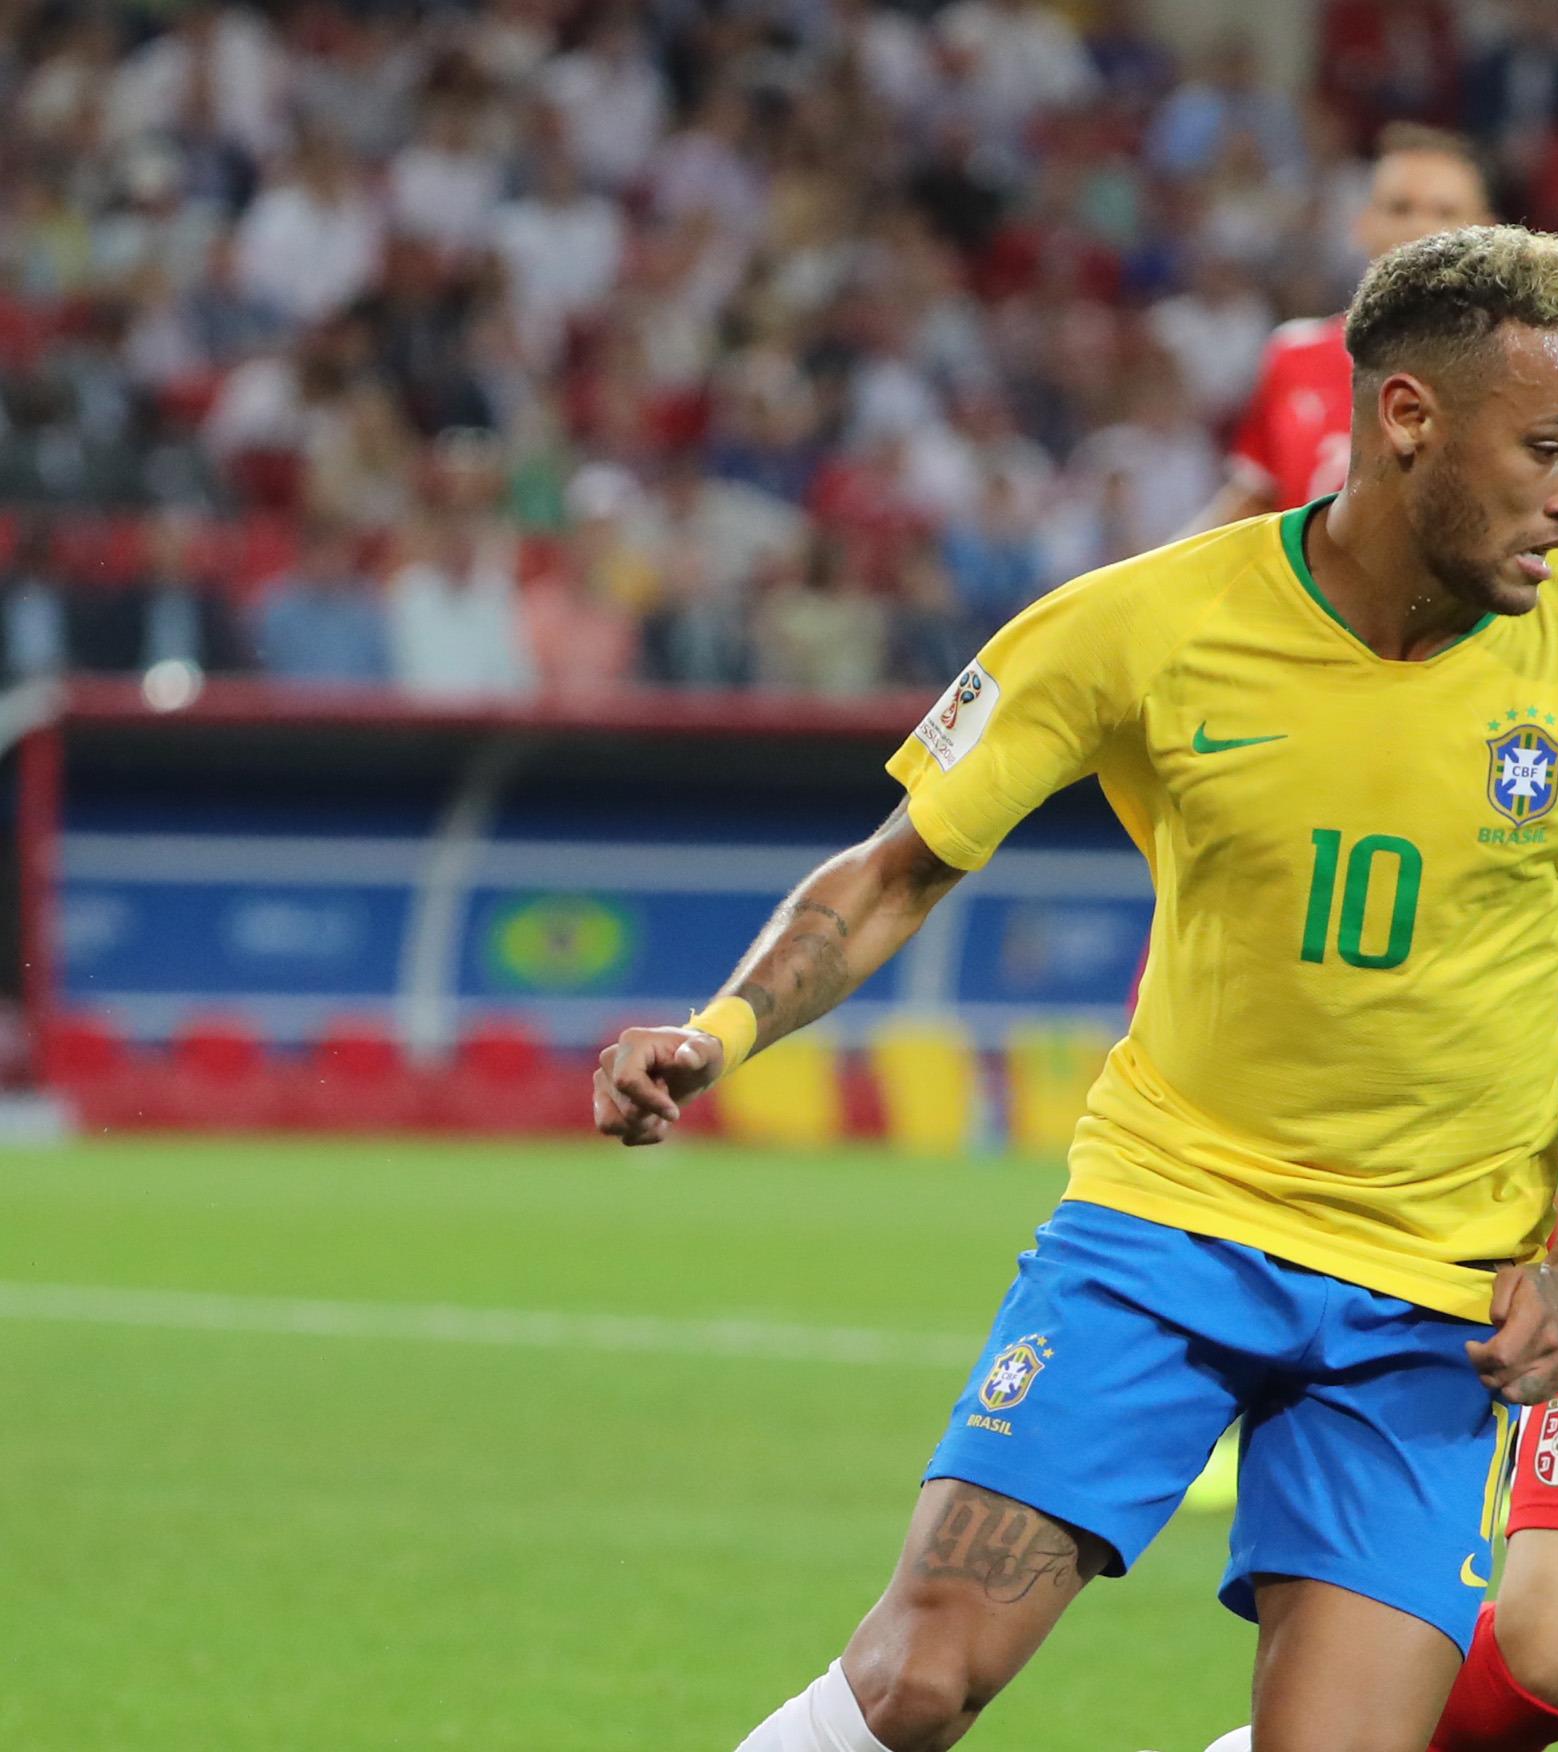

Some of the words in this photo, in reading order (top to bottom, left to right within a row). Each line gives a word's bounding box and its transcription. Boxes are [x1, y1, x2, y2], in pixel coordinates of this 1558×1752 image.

[1512, 765, 1539, 778] CBF
[1478, 827, 1547, 845] BRASIL
[1300, 828, 1423, 970] 10
[966, 1413, 1013, 1436] BRASIL
